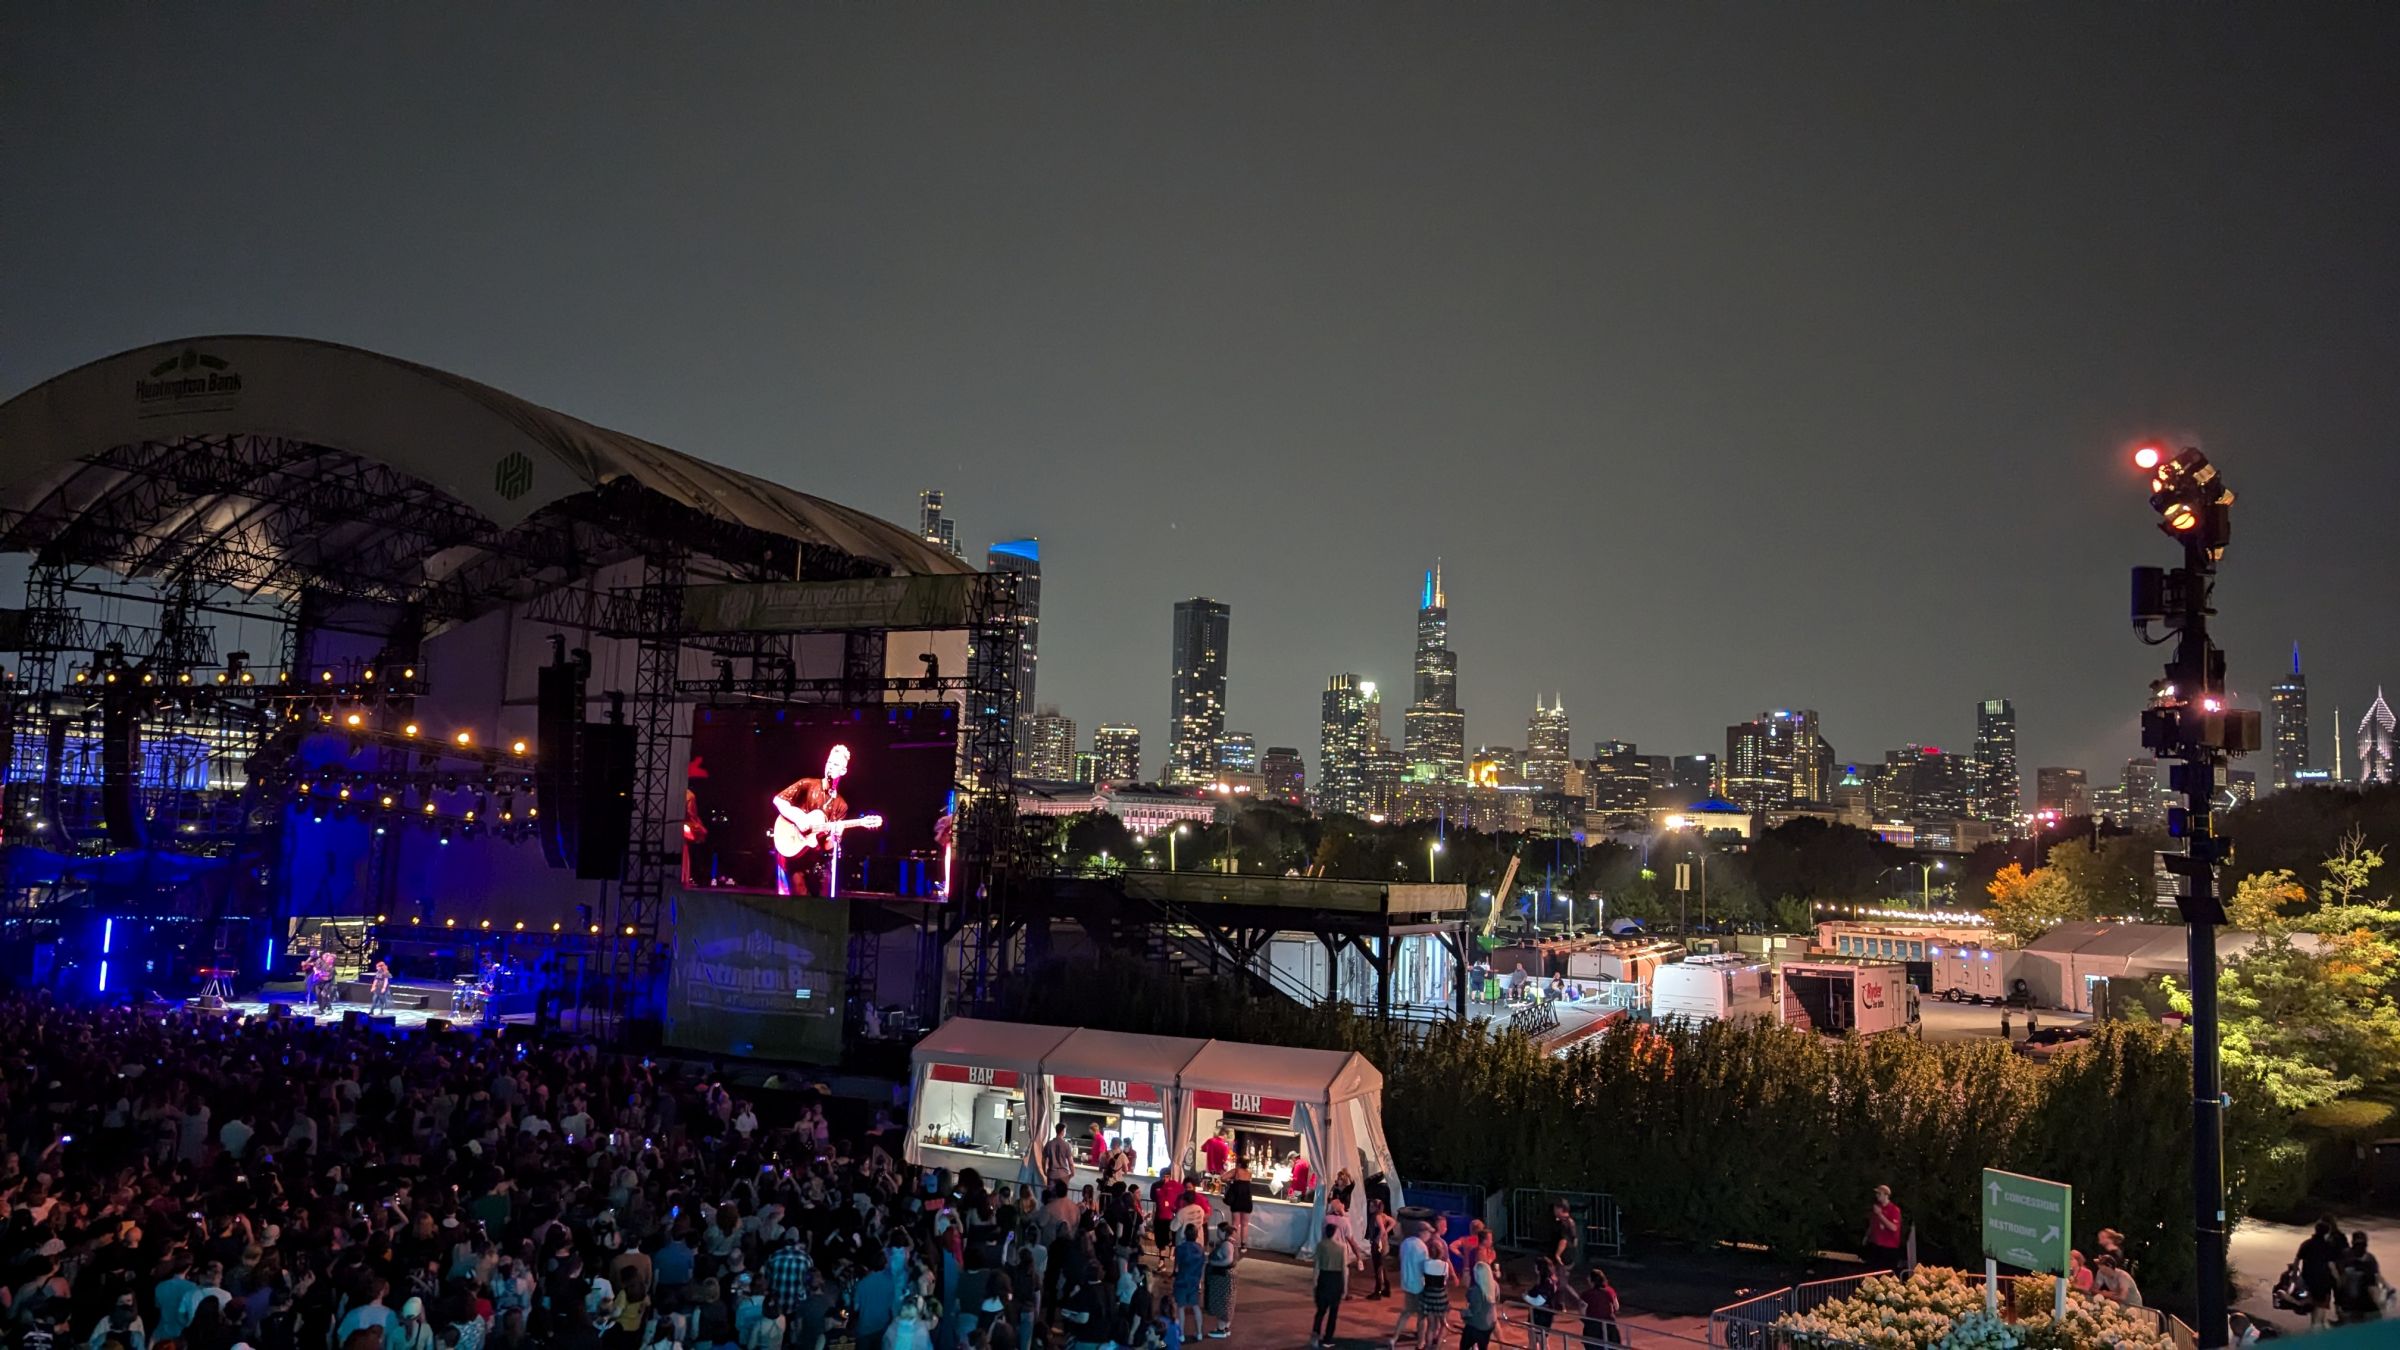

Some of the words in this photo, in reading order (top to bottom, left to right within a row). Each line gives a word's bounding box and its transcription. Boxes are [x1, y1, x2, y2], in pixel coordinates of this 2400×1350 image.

[208, 372, 242, 391] Bank
[1866, 982, 1882, 1001] Ryder
[968, 1066, 994, 1085] BAR
[1100, 1079, 1127, 1098] BAR
[1231, 1092, 1261, 1113] BAR
[2004, 1191, 2060, 1213] CONCESSIONS
[1988, 1218, 2037, 1239] RESTROOMS
